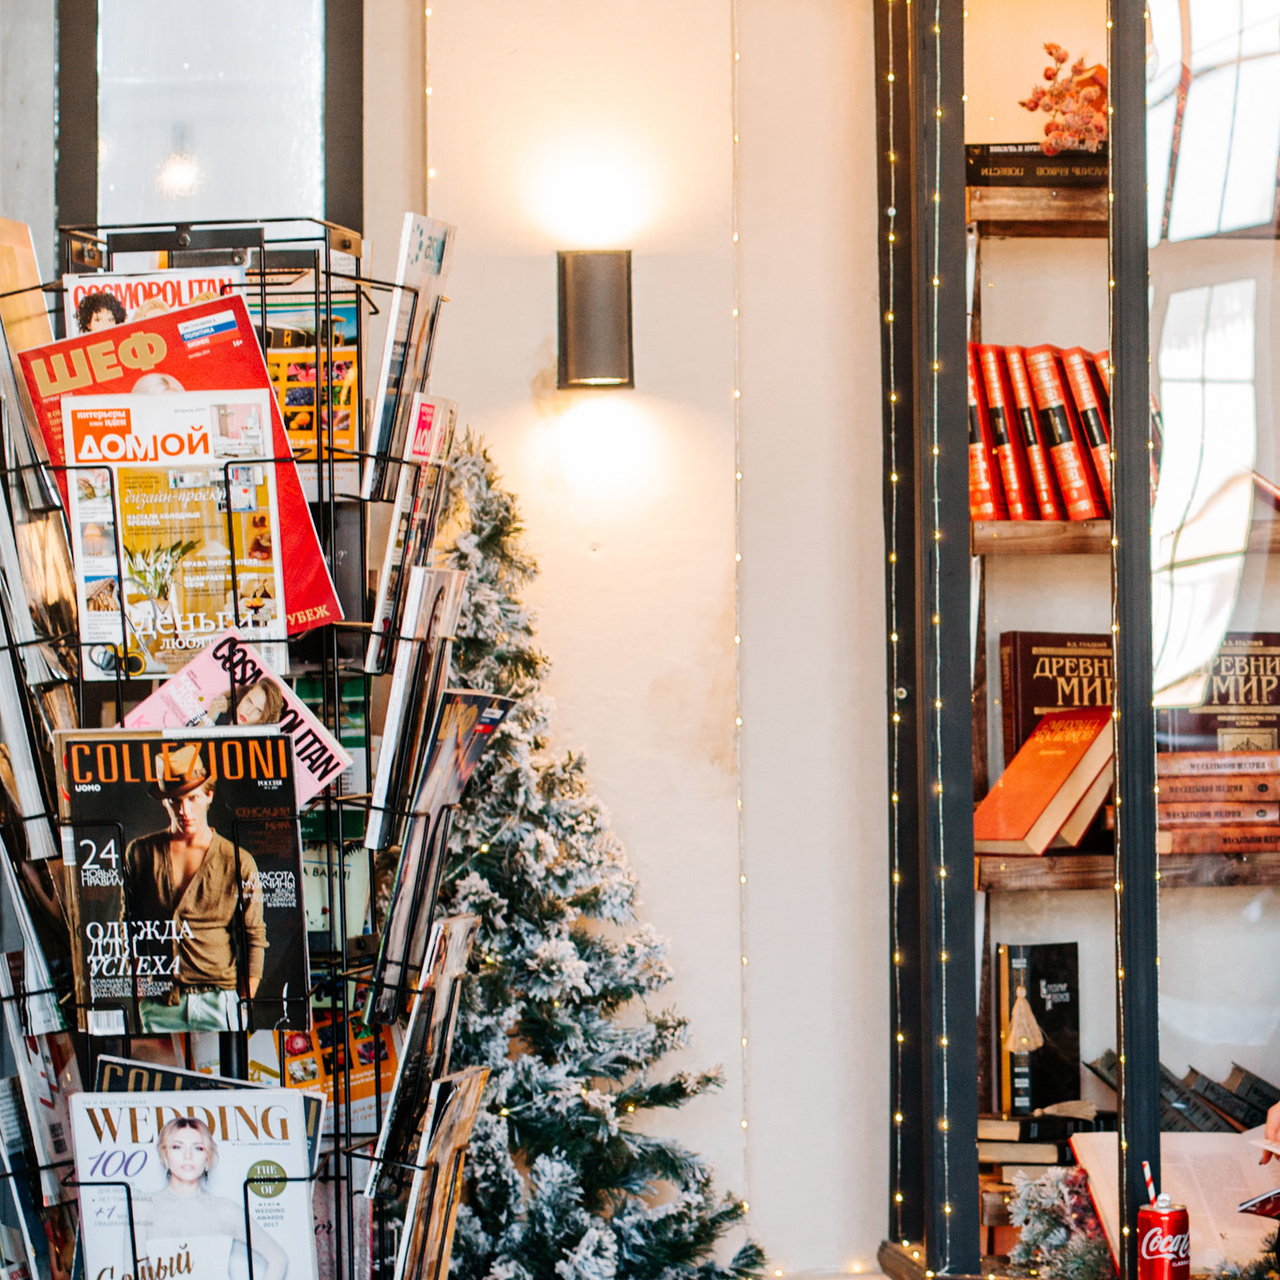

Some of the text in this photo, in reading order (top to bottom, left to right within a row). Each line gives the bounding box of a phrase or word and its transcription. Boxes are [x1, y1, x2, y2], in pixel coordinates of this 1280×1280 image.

[981, 167, 1024, 176] ПОВЕСТИ
[1036, 167, 1069, 176] БЫКОВ
[30, 331, 168, 399] ШЕФ
[77, 410, 127, 420] интерьеры
[104, 419, 127, 428] идеи
[78, 425, 210, 462] ДОМОЙ
[135, 610, 260, 639] деньги
[1211, 675, 1279, 705] МИР
[71, 738, 288, 785] COLLEZIONI
[75, 784, 102, 792] UOMO
[80, 838, 119, 869] 24
[81, 869, 119, 878] НОВЫХ
[250, 871, 295, 881] КРАСОТА
[242, 879, 296, 890] МУЖЧИНЫ
[90, 955, 180, 977] УСПЕХА
[83, 1104, 290, 1145] WEDDING
[88, 1149, 148, 1178] 100
[254, 1165, 277, 1174] THE
[260, 1185, 275, 1195] OF
